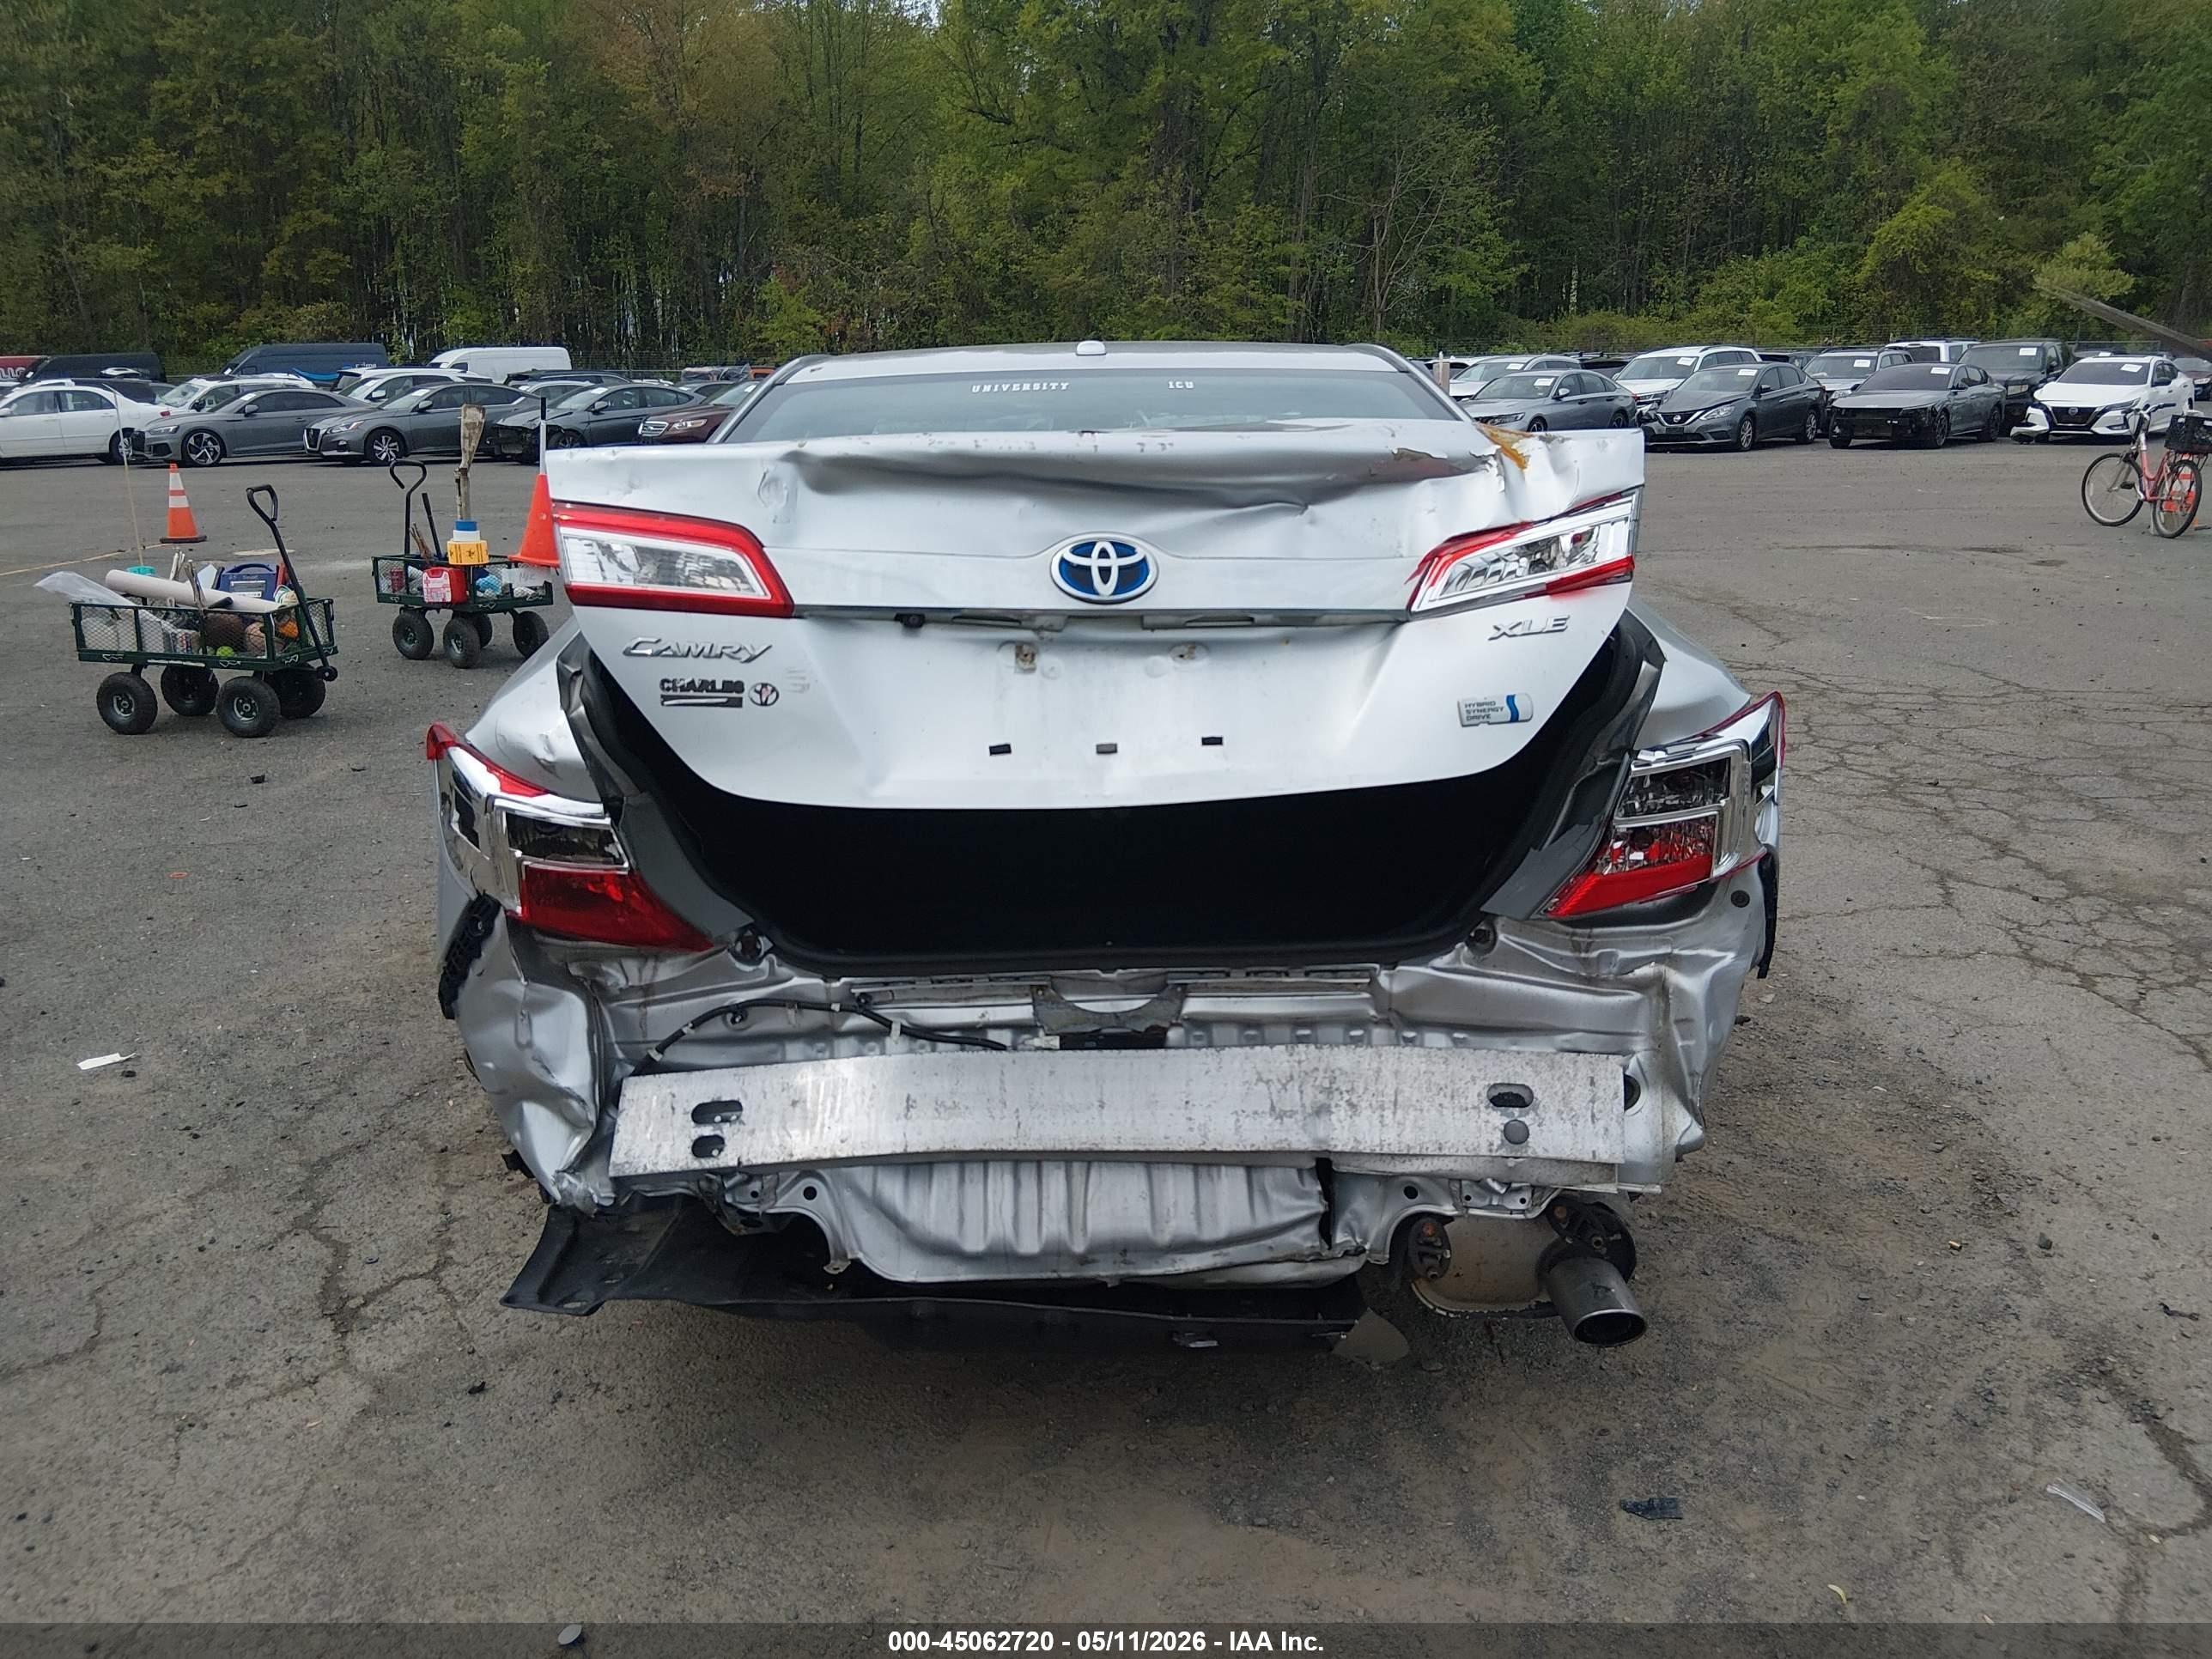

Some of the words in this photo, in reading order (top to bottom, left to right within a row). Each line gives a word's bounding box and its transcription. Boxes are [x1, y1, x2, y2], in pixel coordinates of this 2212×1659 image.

[971, 382, 1070, 393] UNIVERSITY
[1488, 616, 1571, 641] XLE
[623, 637, 774, 664] CAMRY
